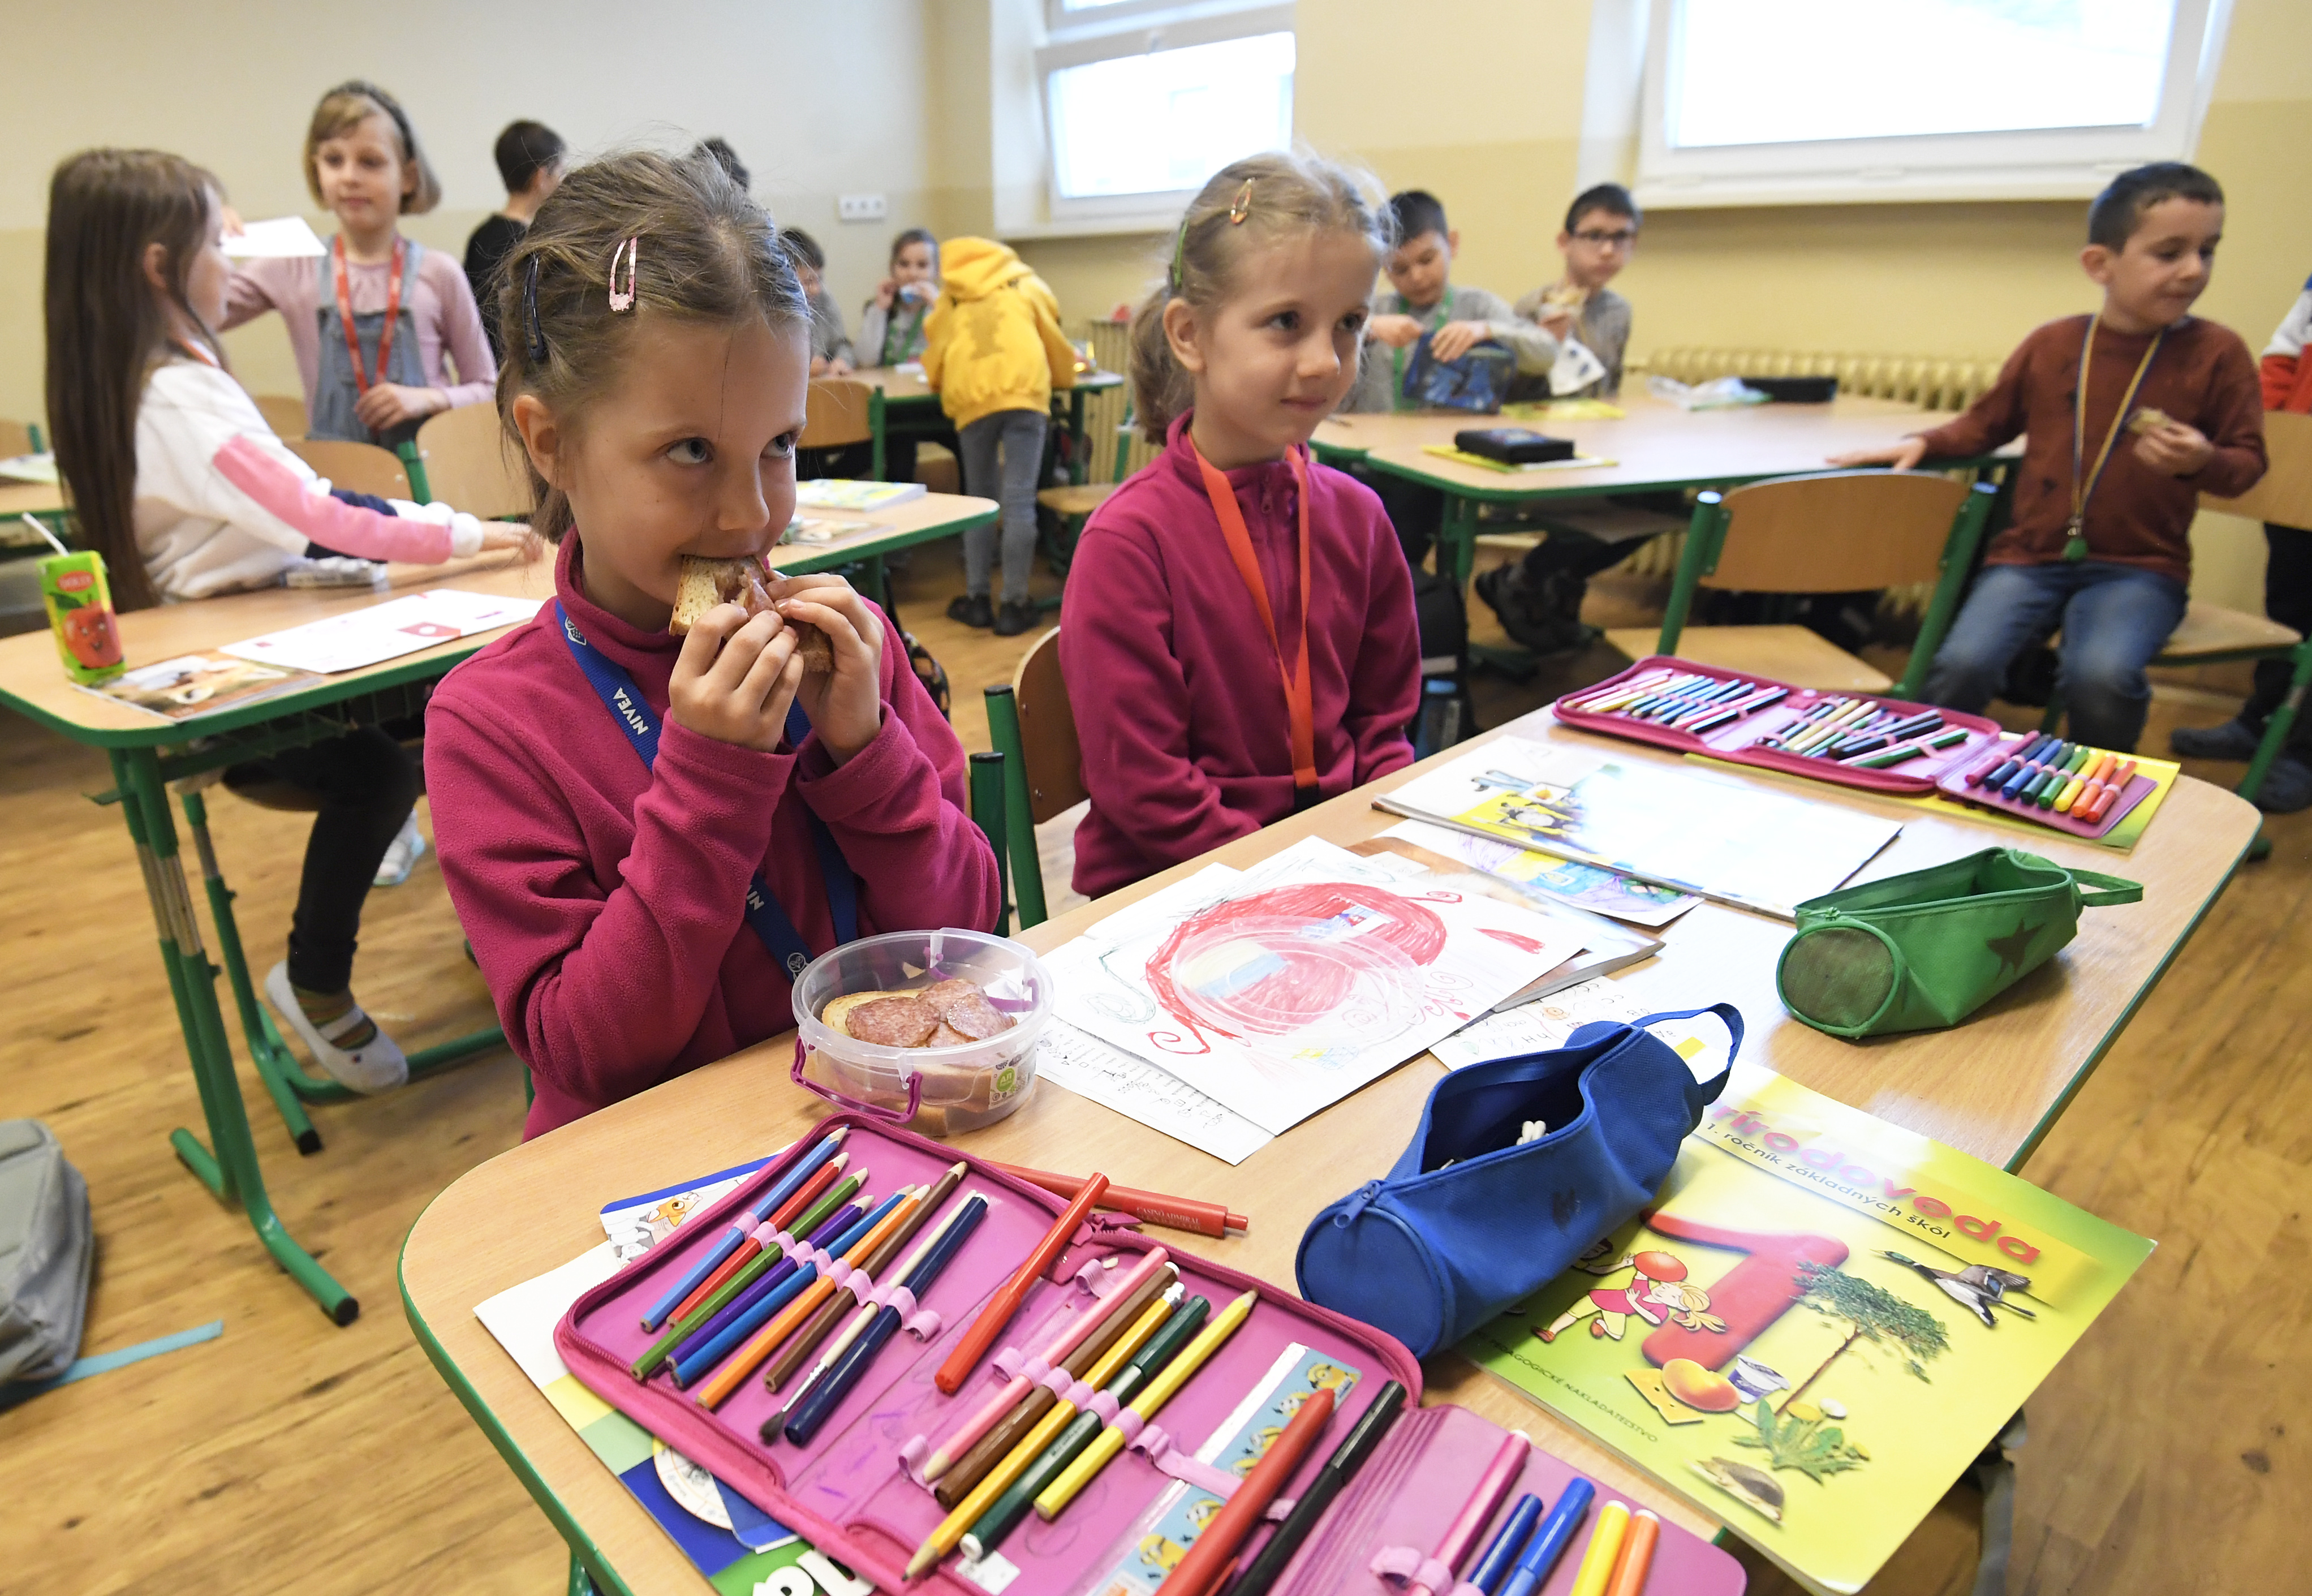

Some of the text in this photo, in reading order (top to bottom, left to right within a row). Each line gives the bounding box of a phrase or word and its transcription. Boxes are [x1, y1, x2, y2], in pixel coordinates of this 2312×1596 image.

[613, 686, 649, 735] NIVEA
[1166, 1212, 1200, 1224] ADMIRAL
[1713, 1099, 2040, 1264] rírodoveda
[1724, 1133, 1783, 1165] ročník
[1785, 1163, 1902, 1217] základných
[1906, 1214, 1951, 1239] škôl
